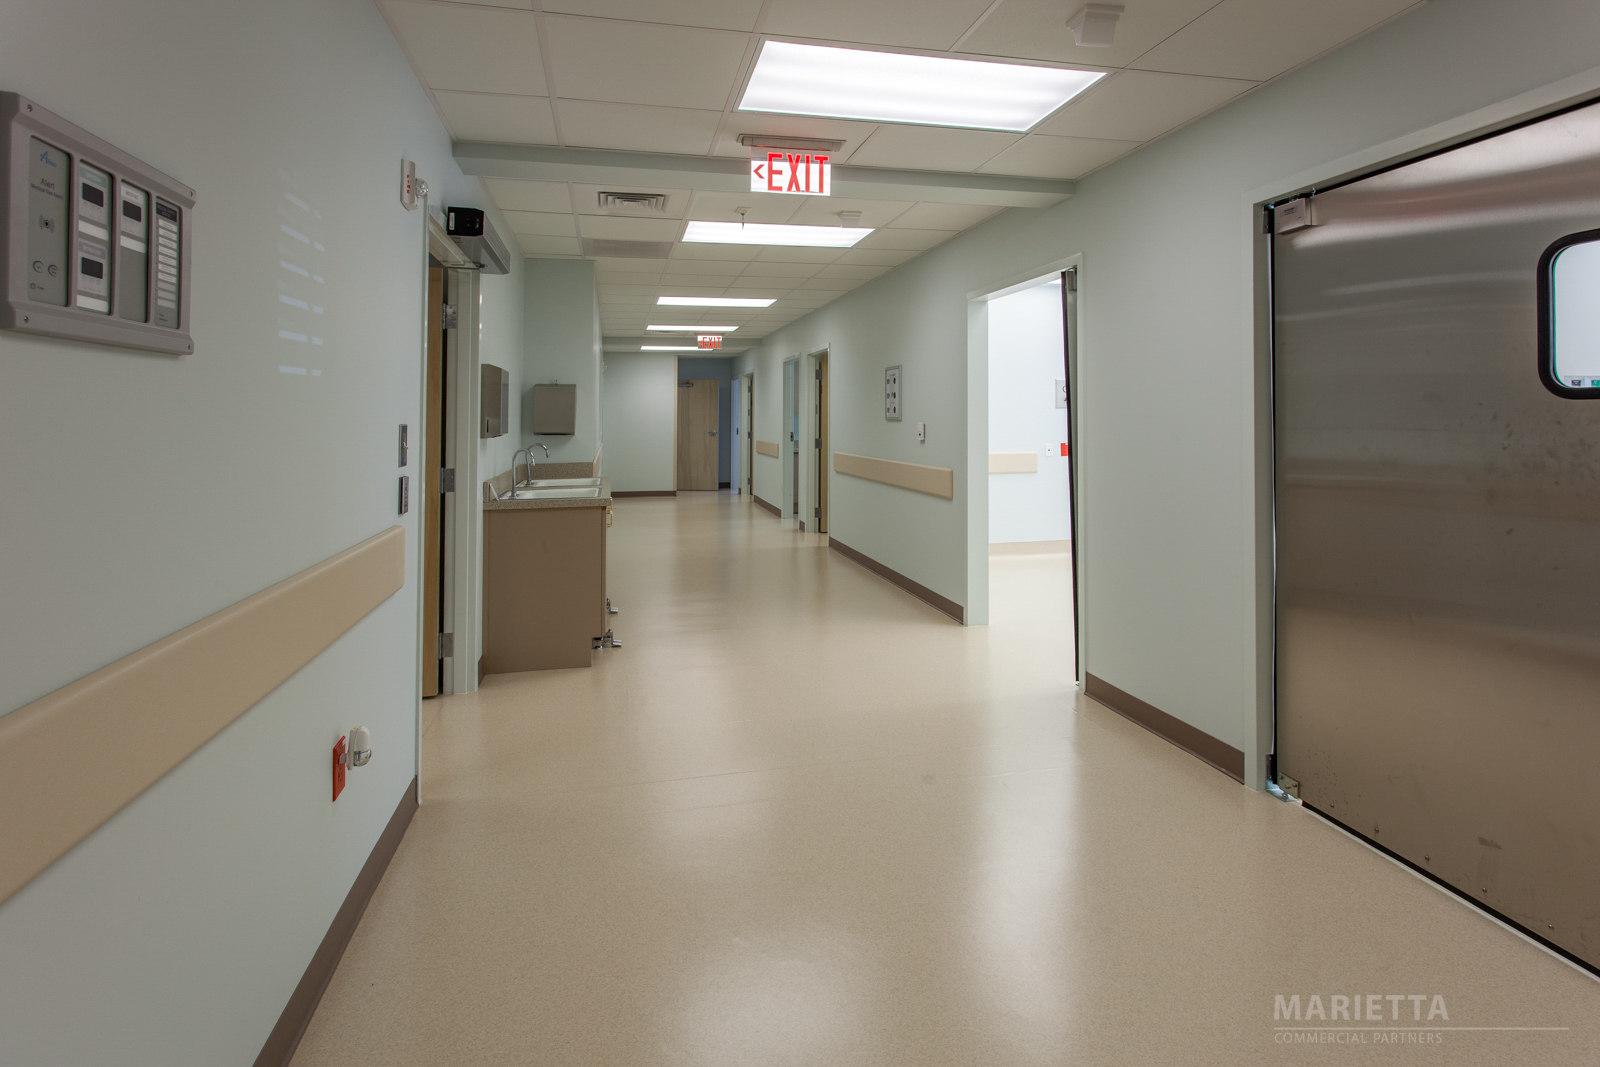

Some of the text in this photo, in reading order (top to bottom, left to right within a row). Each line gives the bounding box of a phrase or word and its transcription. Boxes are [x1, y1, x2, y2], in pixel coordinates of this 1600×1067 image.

[767, 151, 829, 194] EXIT
[41, 178, 55, 190] Alert
[702, 336, 721, 349] EXIT
